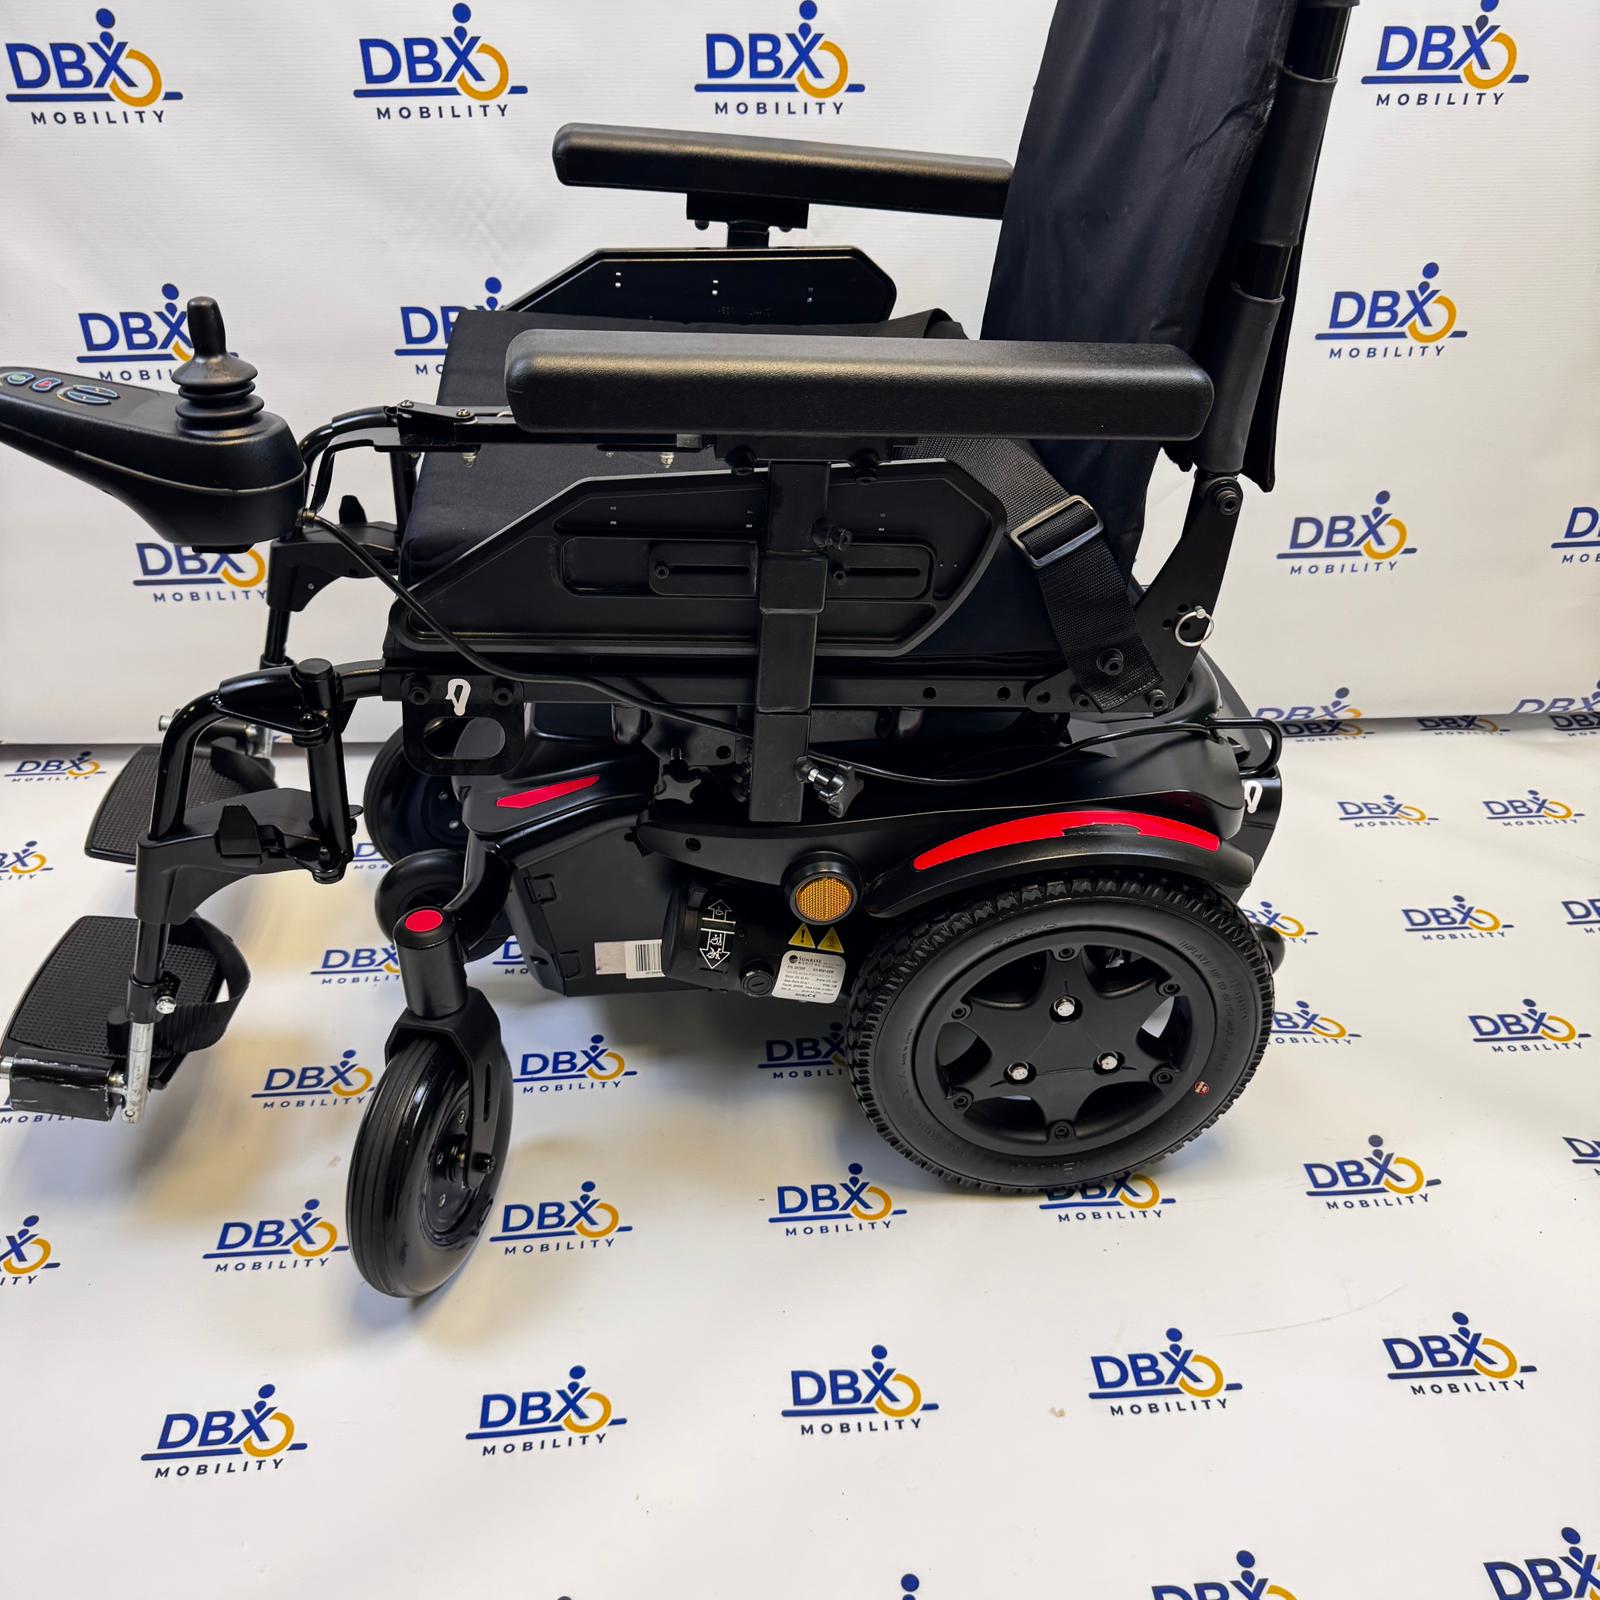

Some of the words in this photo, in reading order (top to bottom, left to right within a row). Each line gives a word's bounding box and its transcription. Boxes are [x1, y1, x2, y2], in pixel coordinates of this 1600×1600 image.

[706, 33, 824, 79] DBX
[1376, 25, 1501, 71] DBX
[6, 41, 138, 88] DBX
[359, 36, 485, 84] DBX
[1376, 92, 1505, 106] MOBILITY
[376, 104, 509, 120] MOBILITY
[714, 102, 844, 115] MOBILITY
[31, 110, 166, 125] MOBILITY
[1329, 290, 1440, 329] DBX
[1329, 345, 1446, 359] MOBILITY
[99, 368, 172, 381] MOBI
[1289, 513, 1392, 550] DBX
[1290, 561, 1398, 575] MOBILITY
[153, 591, 267, 602] MOBILITY
[15, 759, 93, 772] DBX
[1337, 801, 1413, 816] DBX
[1483, 799, 1559, 815] DBX
[1354, 820, 1431, 828] MOBILITY
[1502, 819, 1578, 827] MOBILITY
[1402, 907, 1486, 926] DBX
[1422, 931, 1505, 940] MOBILITY
[321, 974, 400, 984] MOBILIT
[1273, 1011, 1330, 1030] BX
[1468, 1012, 1560, 1036] DBX
[1275, 1037, 1351, 1045] OBILITY
[1492, 1042, 1583, 1053] MOBILITY
[520, 1049, 609, 1077] DBX
[264, 1063, 358, 1090] DBX
[773, 1068, 842, 1079] MOBILI
[522, 1080, 622, 1094] MOBILITY
[262, 1096, 366, 1109] MOBILITY
[1, 1115, 66, 1123] MOBIL
[1303, 1152, 1406, 1189] DBX
[777, 1182, 873, 1214] DBX
[1326, 1193, 1430, 1210] MOBILITY
[501, 1199, 600, 1233] DBX
[1057, 1210, 1162, 1223] MOBILITY
[215, 1217, 322, 1250] DBX
[785, 1220, 891, 1236] MOBILITY
[504, 1238, 614, 1255] MOBILITY
[215, 1257, 329, 1273] MOBILITY
[1382, 1333, 1498, 1370] DBX
[1090, 1349, 1204, 1390] DBX
[791, 1367, 900, 1406] DBX
[1409, 1379, 1525, 1396] MOBILITY
[479, 1386, 591, 1429] DBX
[1109, 1398, 1229, 1417] MOBILITY
[156, 1406, 278, 1449] DBX
[800, 1417, 922, 1436] MOBILITY
[482, 1433, 607, 1456] MOBILITY
[154, 1458, 284, 1479] MOBILITY
